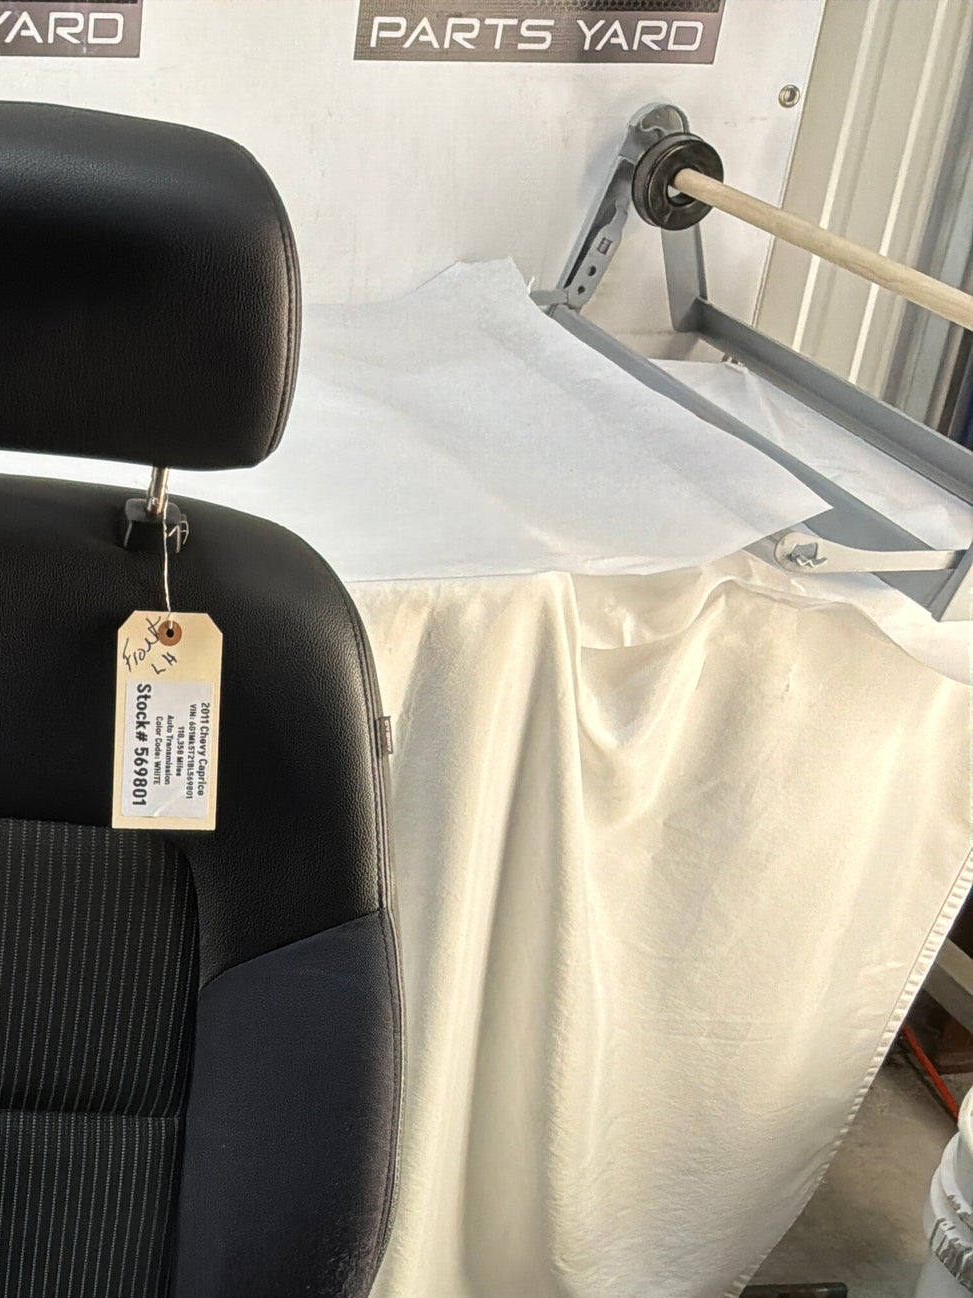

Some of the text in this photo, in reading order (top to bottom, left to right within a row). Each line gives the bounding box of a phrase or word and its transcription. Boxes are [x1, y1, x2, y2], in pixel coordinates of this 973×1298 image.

[369, 15, 704, 52] PARTS YARD
[132, 683, 152, 806] Stock# 569801
[189, 703, 197, 720] VIN:
[153, 716, 163, 785] Color Code: WHITE
[164, 715, 174, 785] Auto Transmission
[176, 756, 184, 777] Miles
[196, 702, 210, 796] 2011 Chevy Caprice
